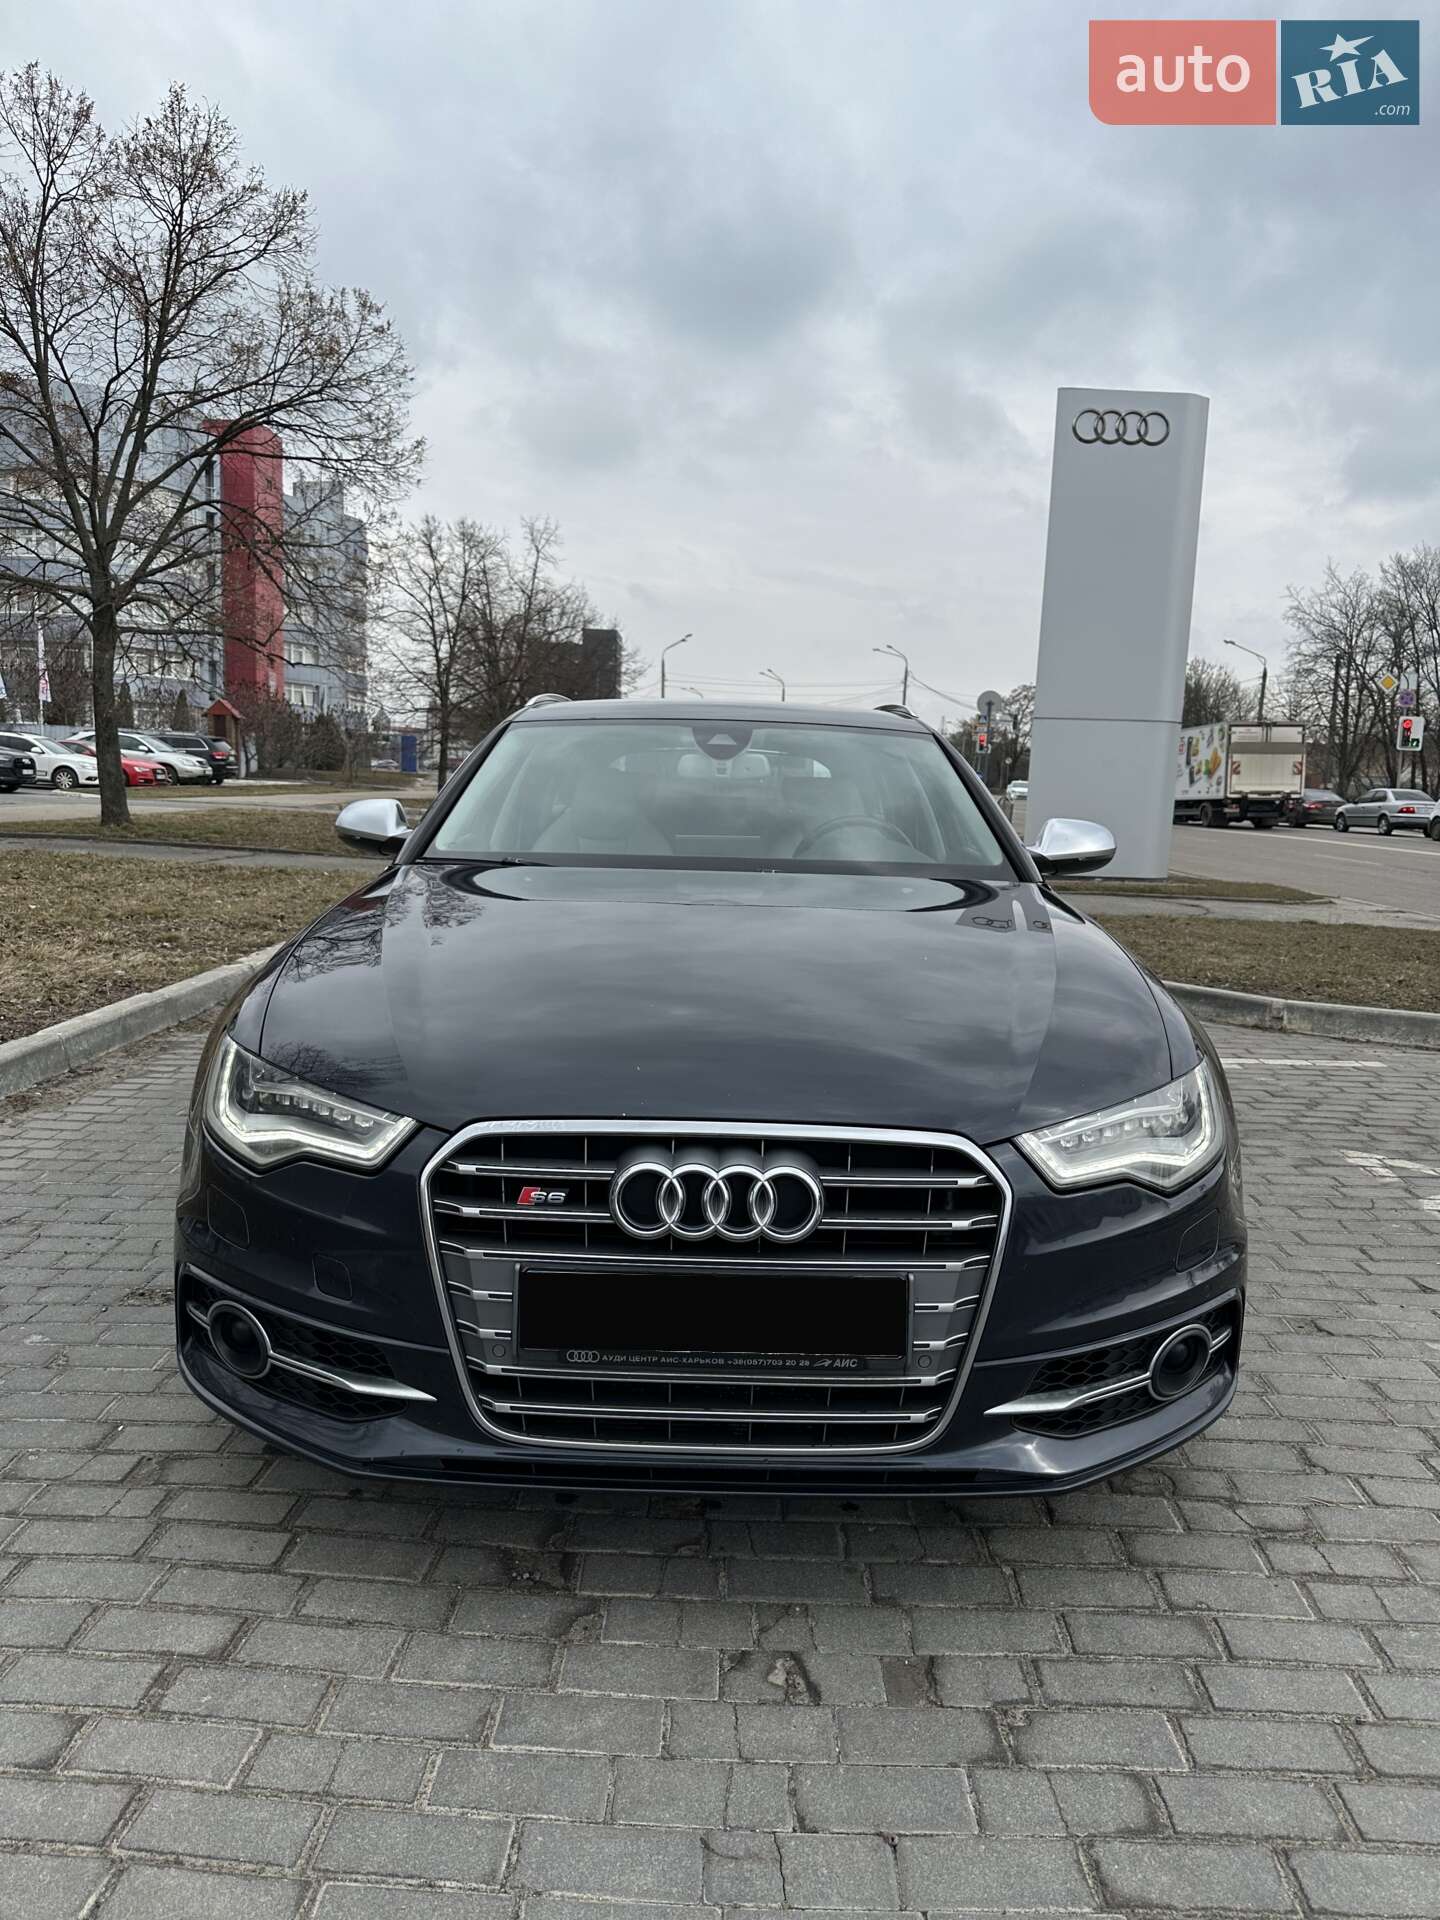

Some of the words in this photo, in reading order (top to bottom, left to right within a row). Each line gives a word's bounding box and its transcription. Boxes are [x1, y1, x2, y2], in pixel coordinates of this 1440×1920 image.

[529, 1190, 567, 1204] S6
[602, 1354, 627, 1362] АУДИ
[628, 1354, 659, 1363] ЦЕНТР
[660, 1355, 725, 1365] АИС-ХАРЬКОВ
[833, 1358, 858, 1368] АИС
